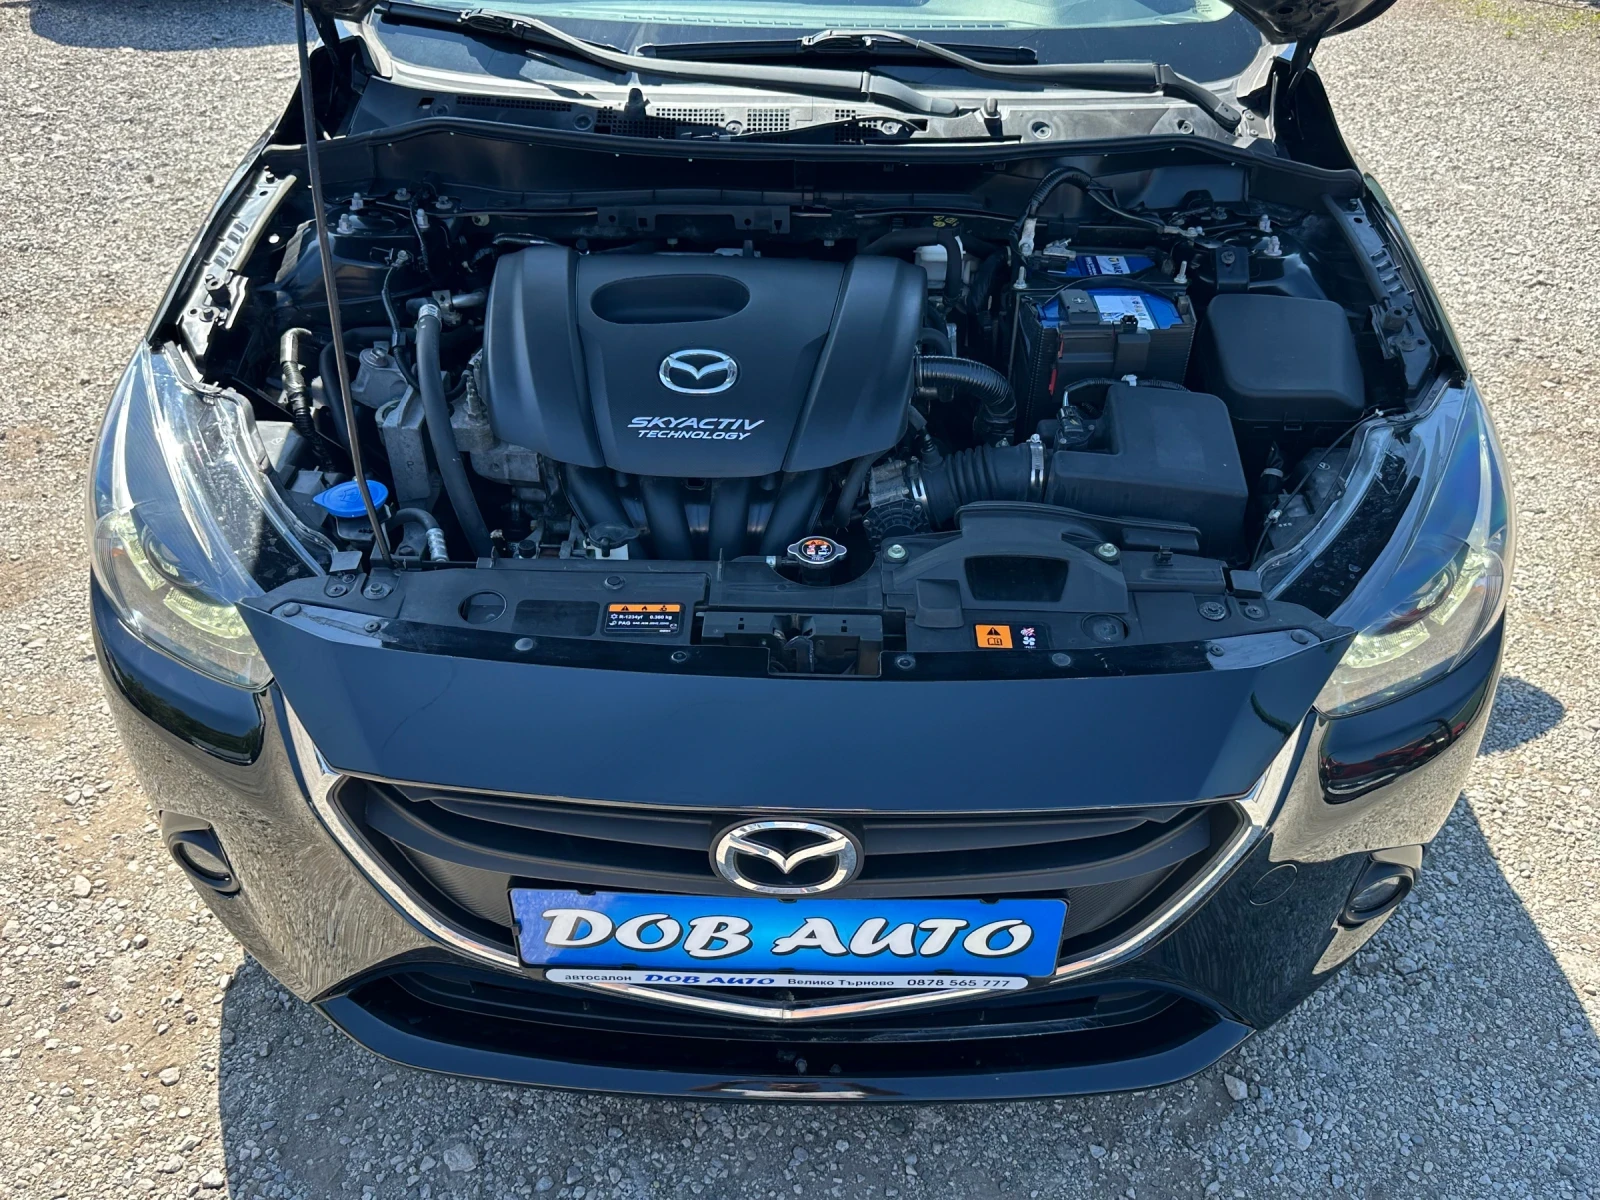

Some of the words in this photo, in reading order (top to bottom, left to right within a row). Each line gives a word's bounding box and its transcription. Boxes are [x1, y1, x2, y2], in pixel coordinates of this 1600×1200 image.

[627, 416, 764, 430] SKYACTIV
[638, 430, 751, 440] TECHNOLOGY
[541, 908, 753, 960] DOB
[772, 917, 1035, 959] AUTO
[564, 974, 633, 982] автосалон
[644, 974, 701, 984] DOB
[706, 976, 775, 985] AUTO
[788, 978, 834, 986] Велико
[839, 979, 895, 987] Търново
[907, 979, 944, 987] 0878
[949, 979, 977, 987] 565
[982, 980, 1010, 988] 777
